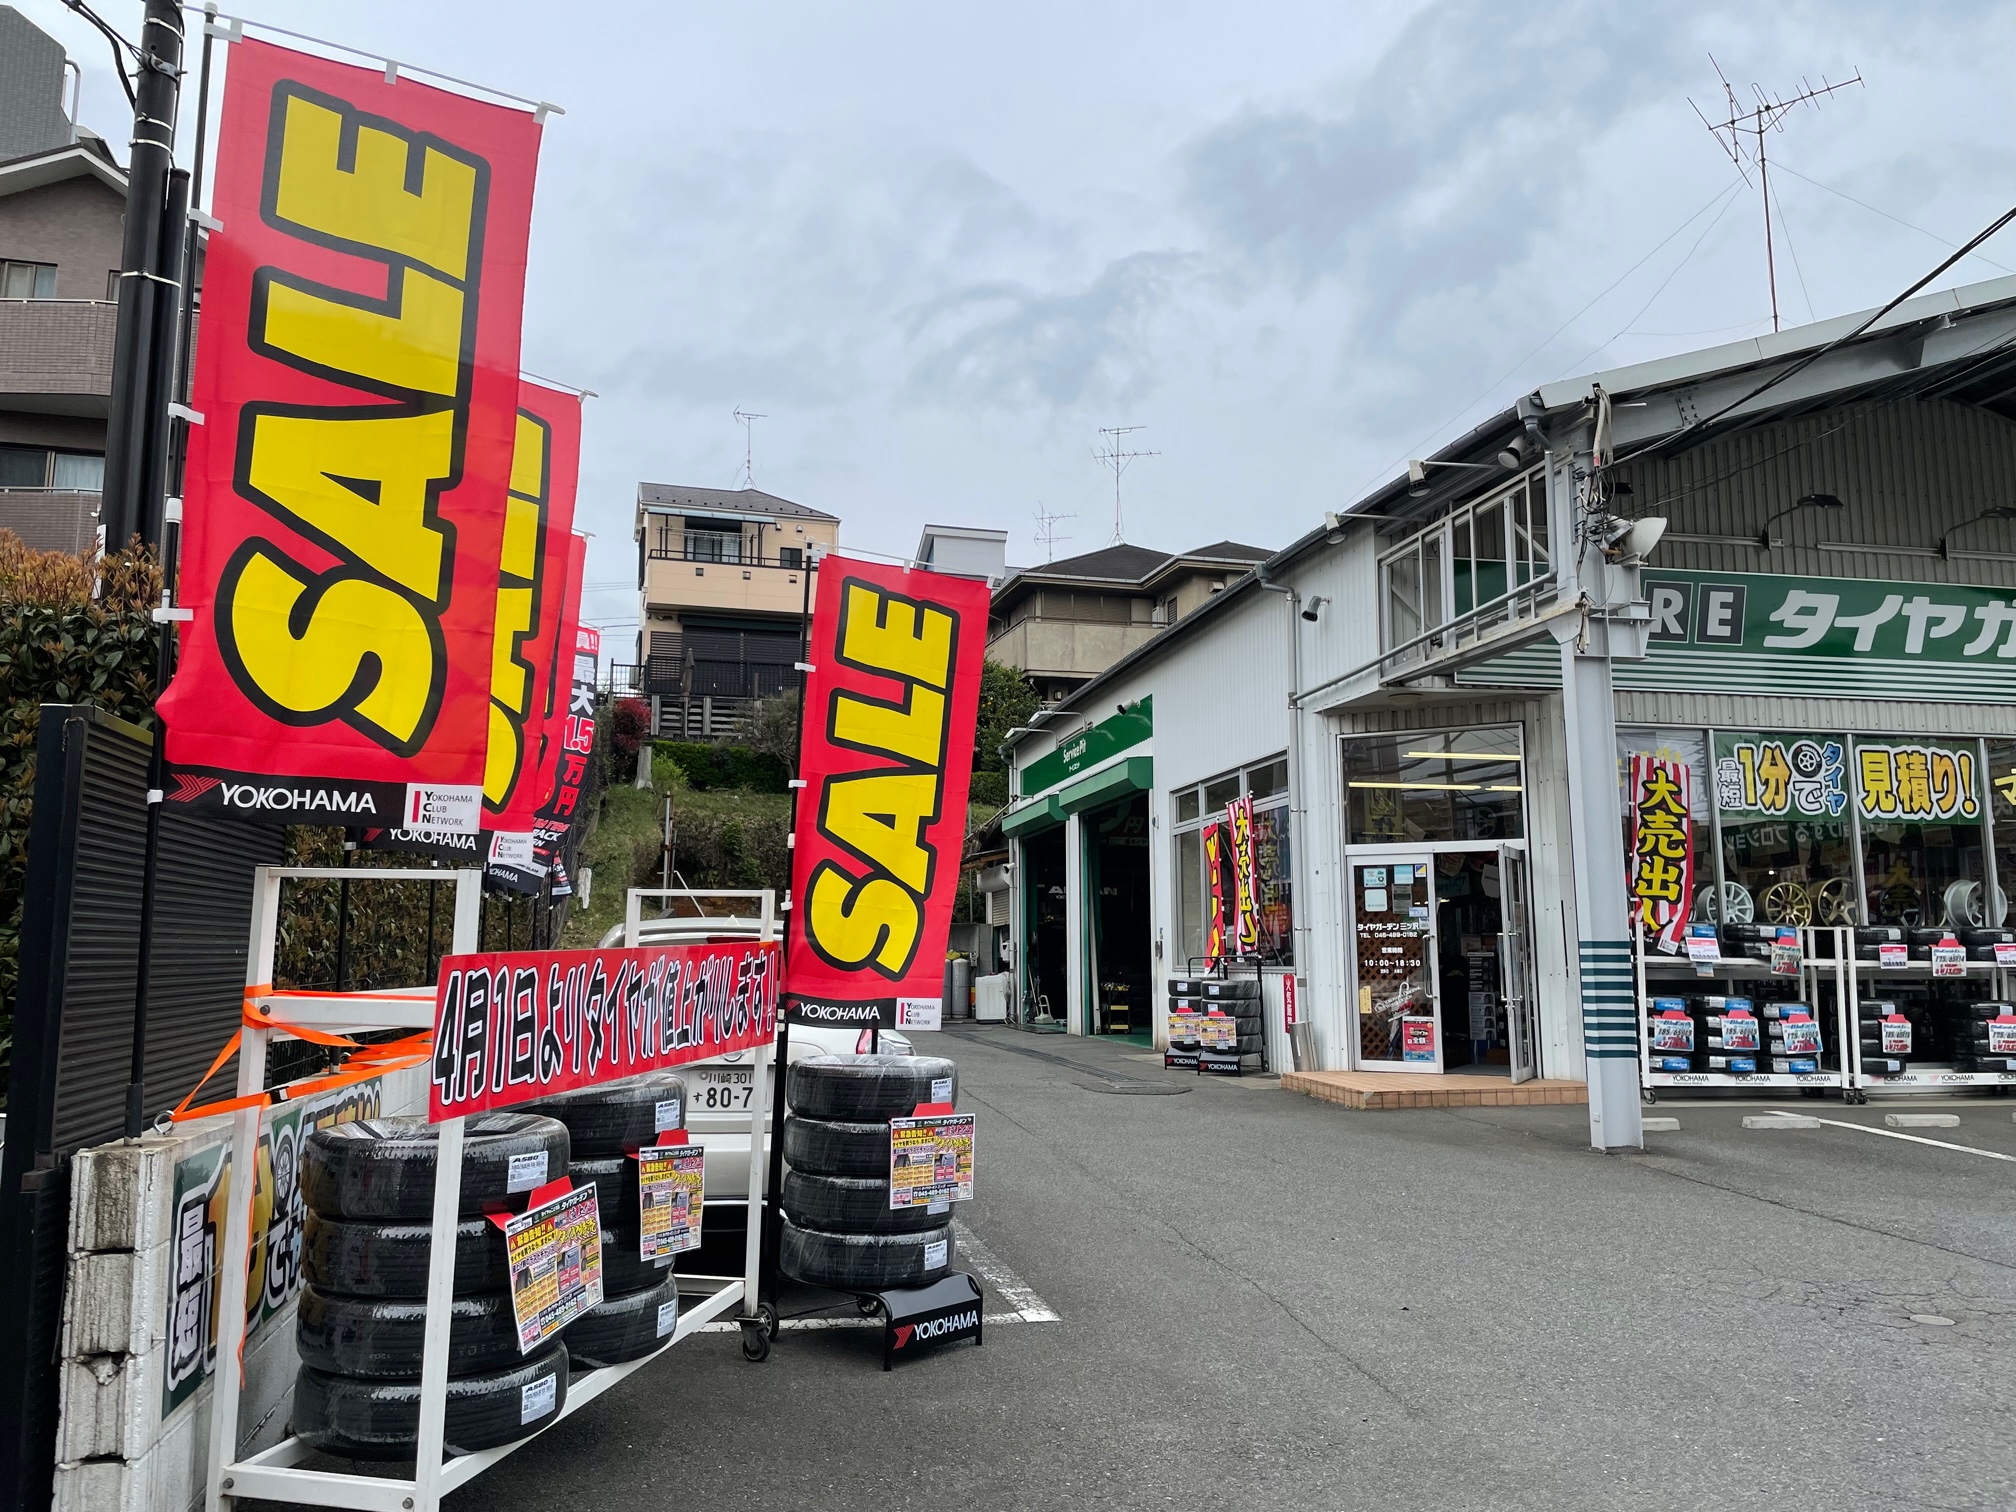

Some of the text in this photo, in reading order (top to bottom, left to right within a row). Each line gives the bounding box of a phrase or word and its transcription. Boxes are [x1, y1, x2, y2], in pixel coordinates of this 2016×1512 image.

[215, 79, 490, 757] SALE
[1063, 744, 1081, 763] Service
[804, 577, 959, 981] SALE
[1718, 761, 1742, 809] 最短
[1822, 743, 1847, 816] タイヤ
[1860, 749, 1979, 815] 見積り!
[221, 783, 377, 814] YOKOHAMA
[423, 804, 447, 814] CLUB
[424, 791, 473, 803] YOKOHAMA
[422, 814, 464, 827] NETWORK
[390, 828, 477, 850] YOKOHAMA
[1637, 767, 1687, 934] 大売出し
[1235, 807, 1256, 946] 大売出し
[1357, 923, 1399, 931] タイヤガーデン
[800, 1002, 880, 1020] YOKOHAMA
[432, 949, 776, 1106] 4月1日よりタイヤが値上がりします!
[693, 1087, 754, 1108] す 80-7
[172, 1202, 206, 1369] 最短
[914, 1310, 978, 1341] YOKOHAMA
